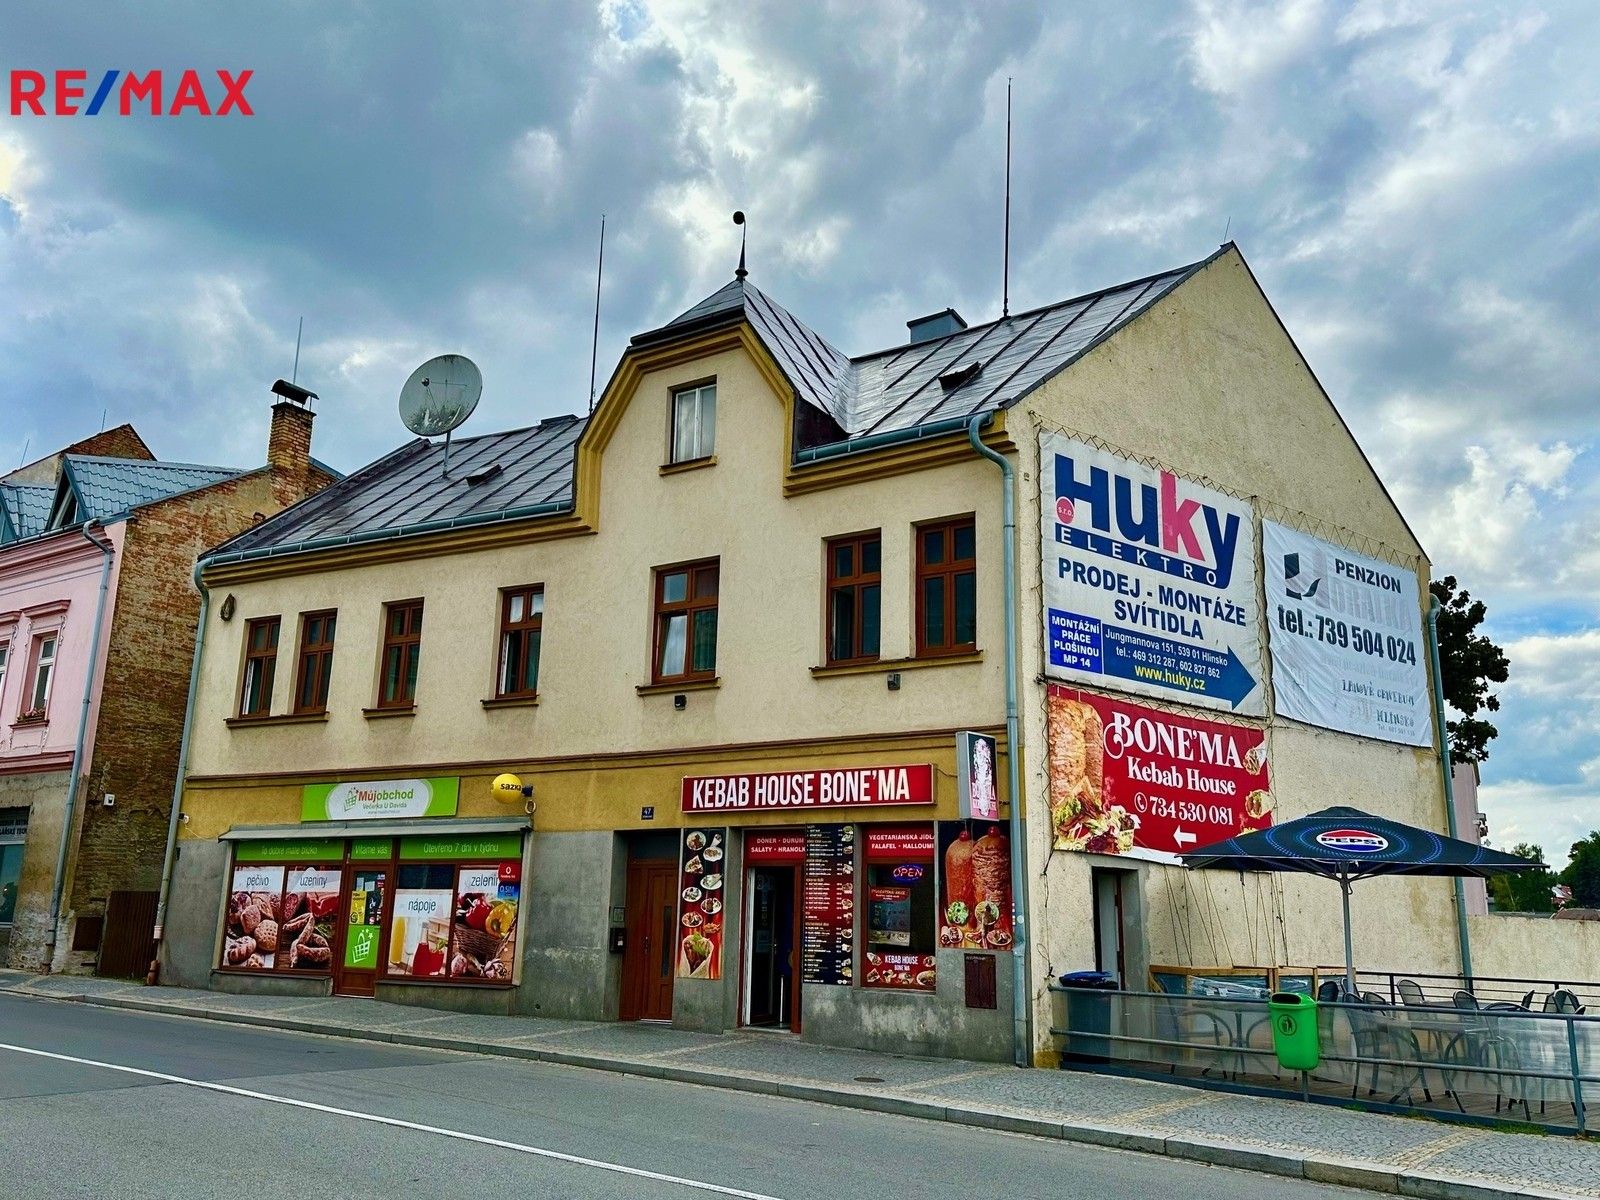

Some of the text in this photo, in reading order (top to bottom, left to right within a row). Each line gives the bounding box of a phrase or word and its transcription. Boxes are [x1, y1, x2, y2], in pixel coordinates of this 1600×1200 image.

[1055, 453, 1240, 588] Huky
[1057, 505, 1074, 518] s.r.o.
[1061, 526, 1217, 585] ELEKTRO
[1335, 558, 1402, 594] PENZION
[1058, 559, 1140, 598] PRODEJ
[1159, 584, 1247, 627] MONTÁŽE
[1052, 615, 1100, 634] MONTÁŽNÍ
[1114, 599, 1204, 640] SVÍTIDLA
[1054, 640, 1099, 657] PLOŠINOU
[1062, 629, 1091, 644] PRÁCE
[1105, 628, 1228, 667] Jungmannova 151, 539 01 Hlinsko
[1277, 603, 1313, 639] tel.:
[1315, 614, 1348, 649] 739
[1351, 625, 1384, 658] 504
[1386, 635, 1416, 666] 024
[1063, 654, 1091, 668] MP 14
[1116, 646, 1220, 678] tel.: 469 312 287, 602 827 862
[1135, 665, 1206, 691] www.huky.cz
[1104, 711, 1244, 769] BONE'MA
[692, 768, 910, 808] KEBAB HOUSE BONE'MA
[1127, 755, 1237, 796] Kebab House
[1149, 796, 1234, 826] 734 530 081
[454, 843, 459, 852] 7
[1321, 837, 1383, 845] PEPSI
[246, 874, 269, 888] pečivo
[893, 868, 923, 878] OPEN
[408, 898, 436, 913] nápoje
[884, 955, 919, 965] KEBAB HOUSE
